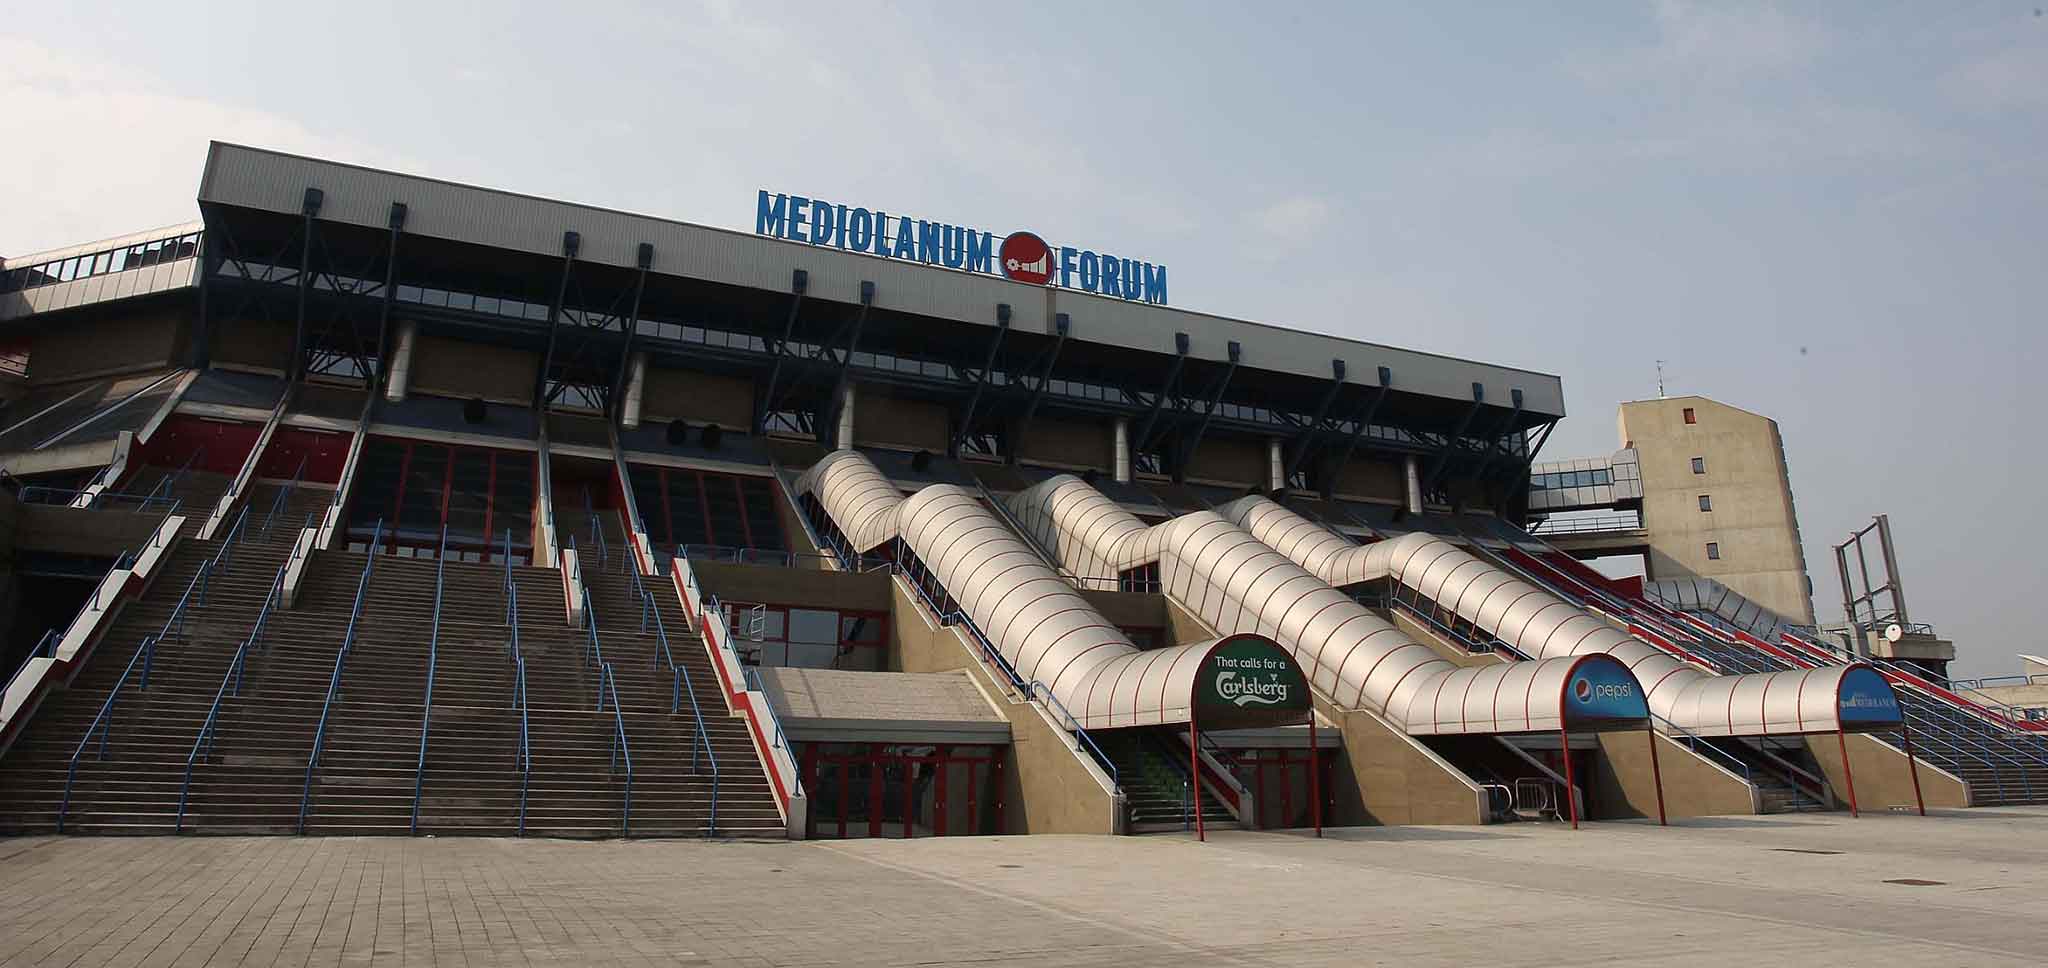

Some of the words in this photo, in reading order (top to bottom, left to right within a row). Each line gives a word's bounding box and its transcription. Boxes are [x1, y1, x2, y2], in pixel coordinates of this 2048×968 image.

[756, 190, 993, 273] MEDIOLANUM
[1061, 246, 1168, 305] FORUM
[1215, 656, 1238, 668] That
[1240, 658, 1262, 669] calls
[1264, 658, 1277, 670] for
[1279, 661, 1286, 670] a
[1216, 671, 1288, 706] Carlsberg
[1595, 682, 1633, 702] pepsi
